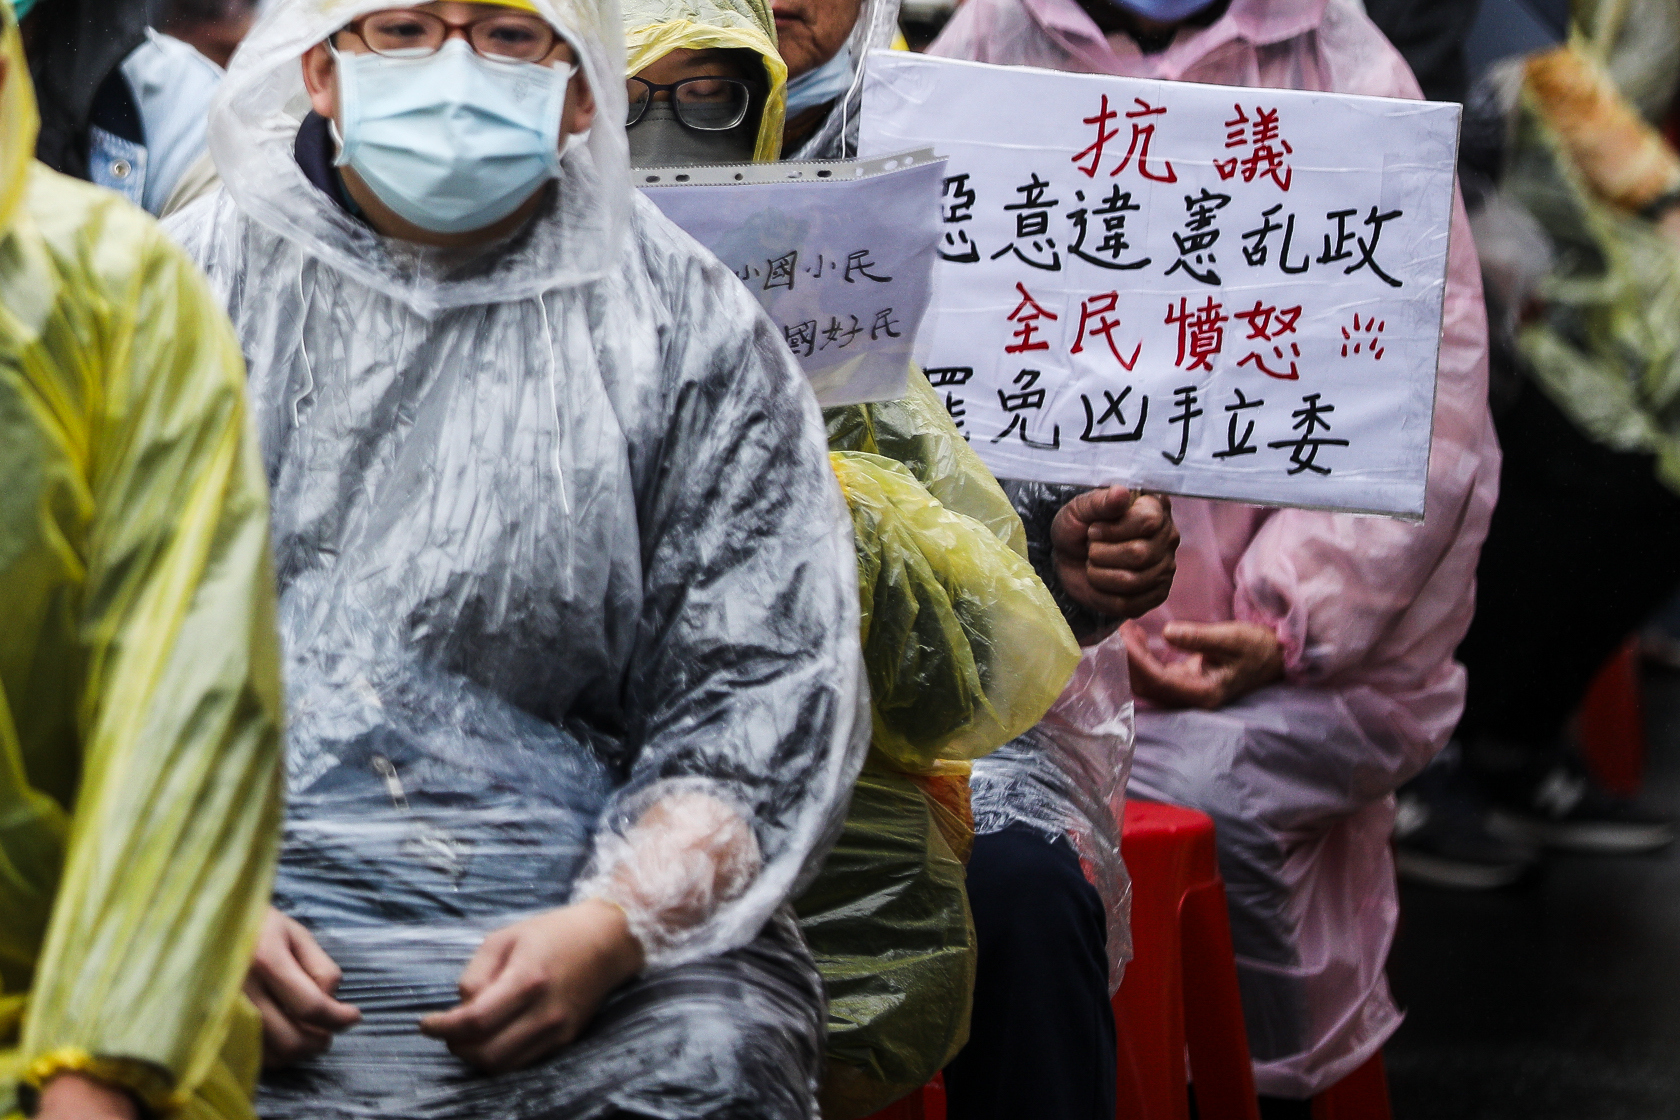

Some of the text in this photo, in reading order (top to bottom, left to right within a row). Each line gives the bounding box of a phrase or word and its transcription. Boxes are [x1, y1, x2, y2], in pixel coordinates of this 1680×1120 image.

[1071, 93, 1293, 191] 抗議
[1004, 281, 1303, 380] 全民憤怒
